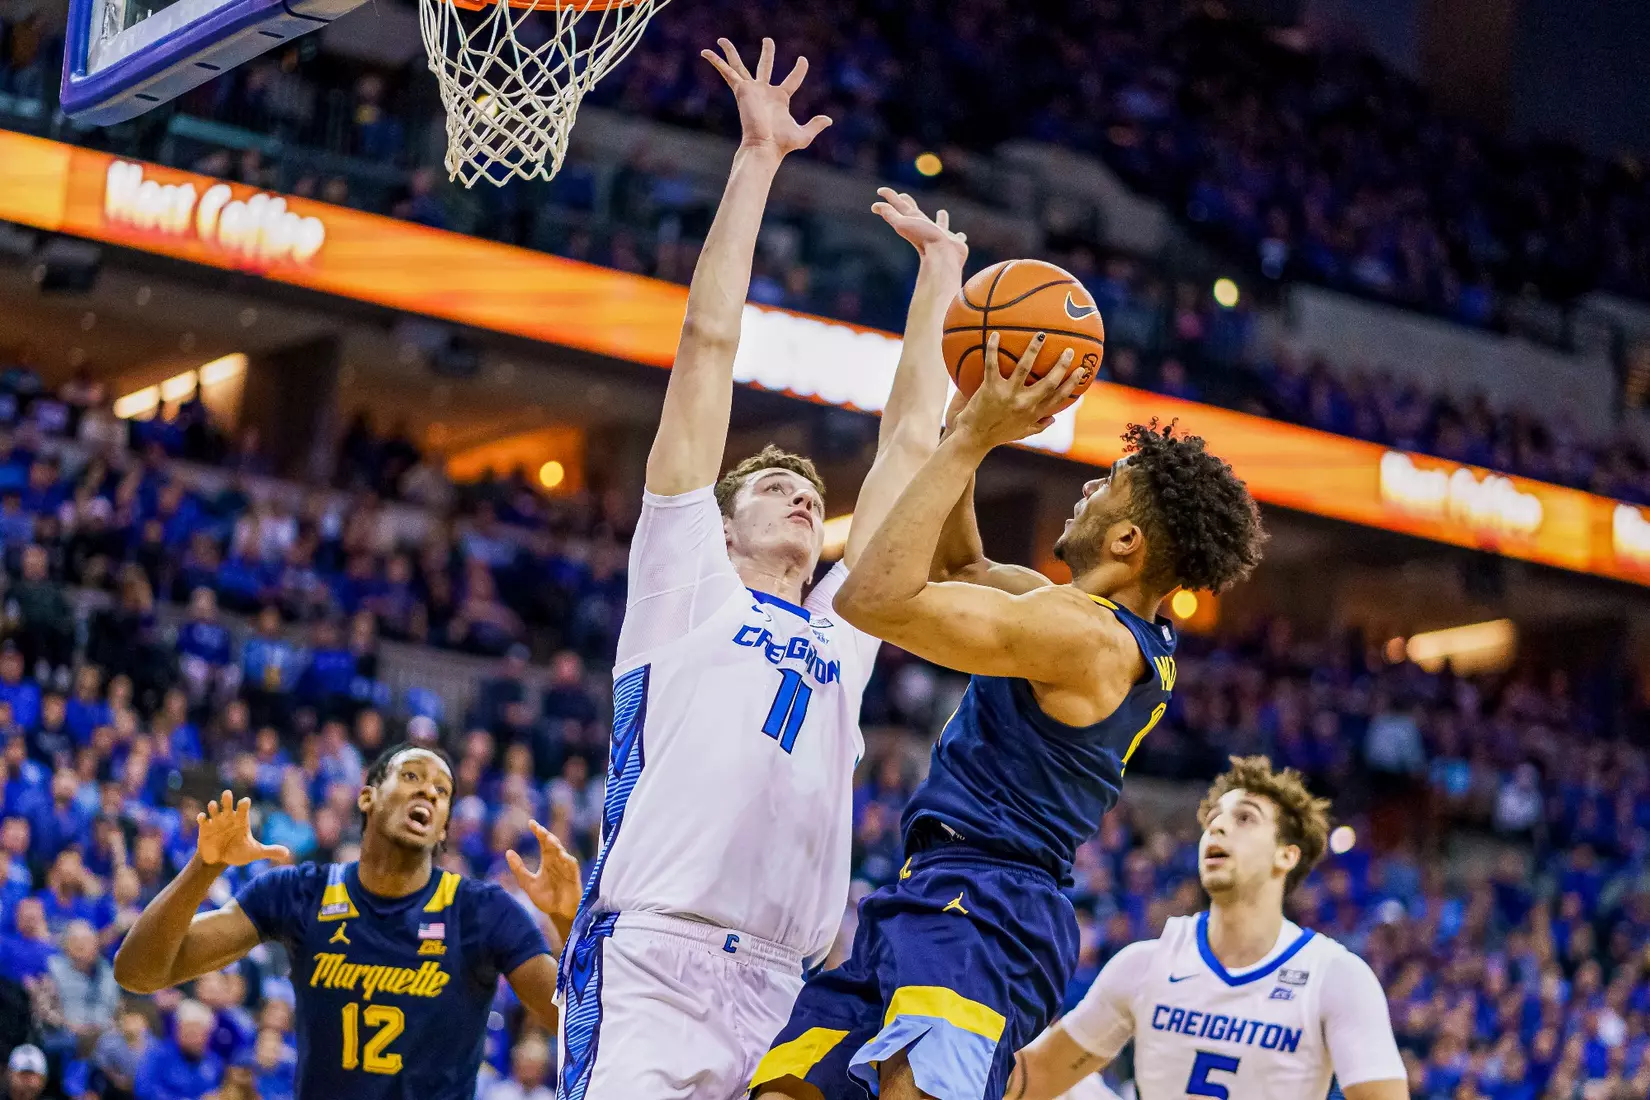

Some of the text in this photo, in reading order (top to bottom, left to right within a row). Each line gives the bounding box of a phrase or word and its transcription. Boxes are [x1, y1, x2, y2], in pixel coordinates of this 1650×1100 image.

[761, 668, 814, 755] 11
[722, 933, 740, 954] C
[310, 952, 451, 1001] Marquette
[342, 1002, 405, 1075] 12
[1152, 1004, 1303, 1053] CREIGHTON
[1186, 1050, 1241, 1100] 5
